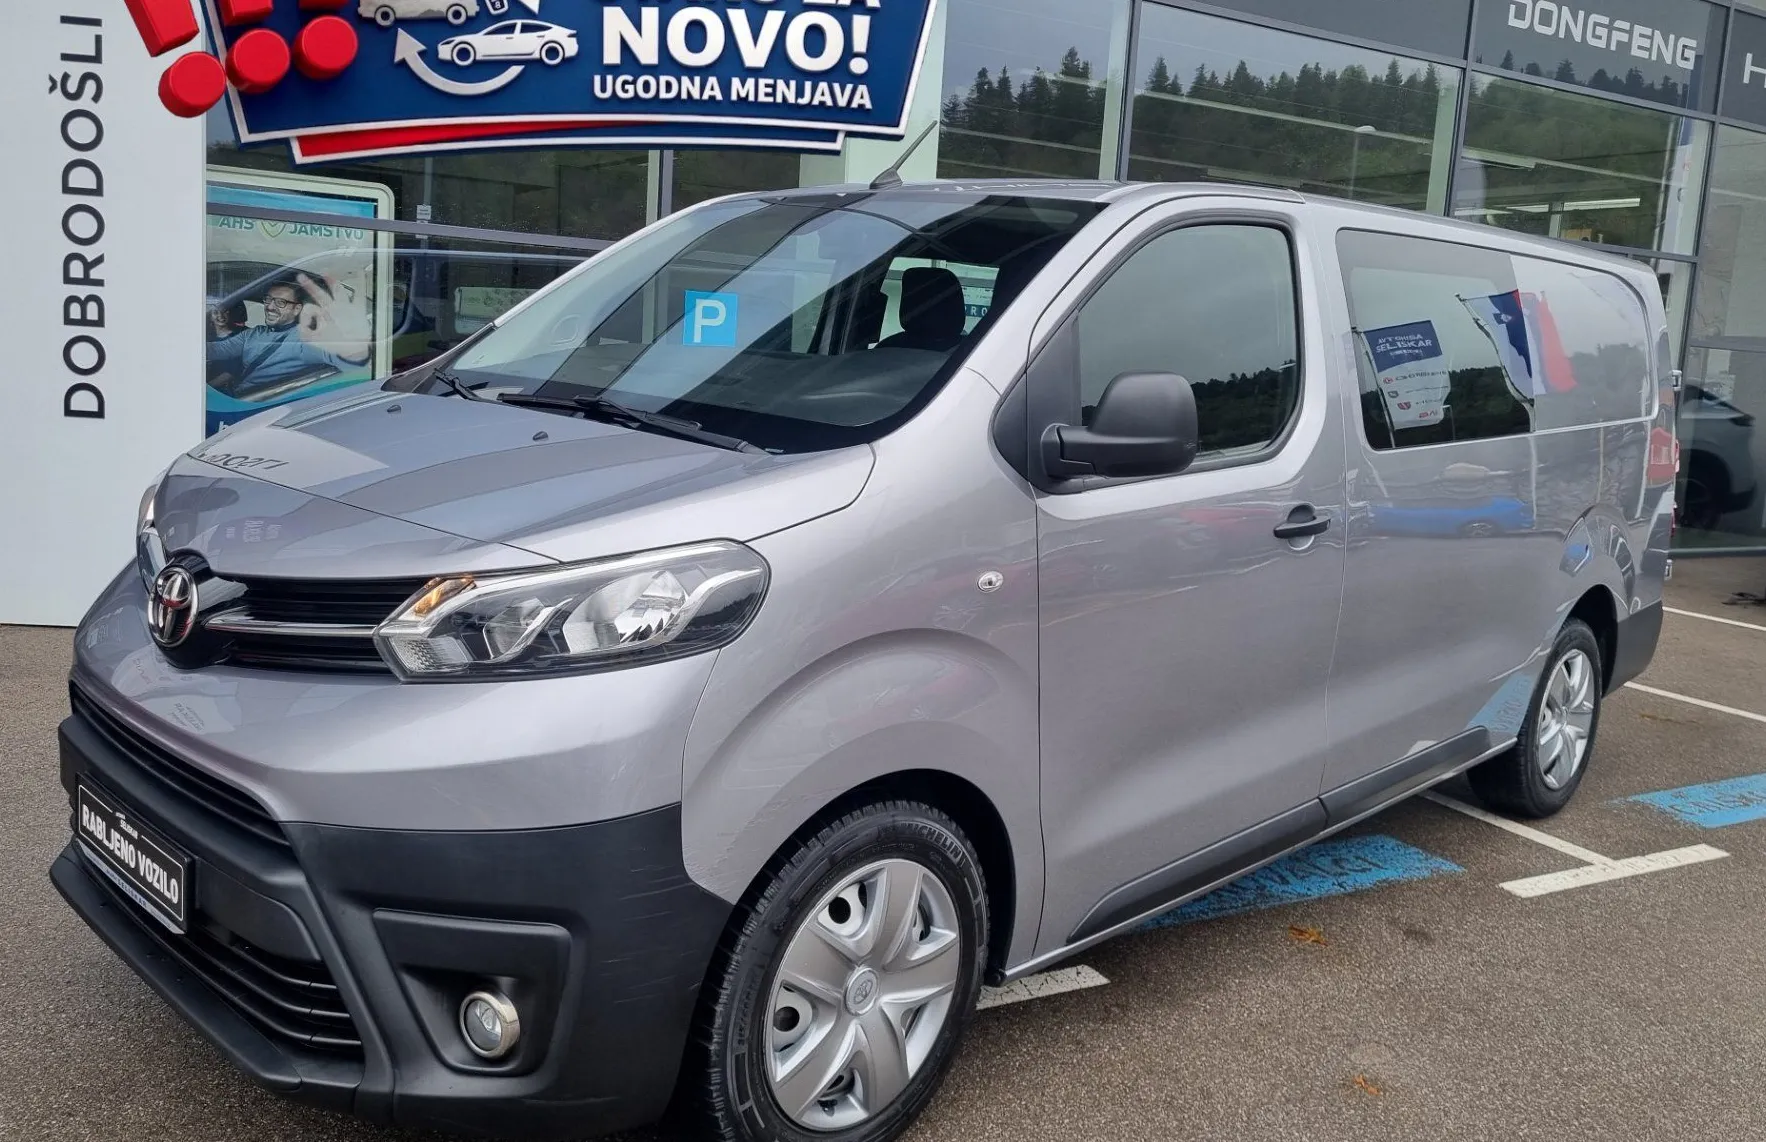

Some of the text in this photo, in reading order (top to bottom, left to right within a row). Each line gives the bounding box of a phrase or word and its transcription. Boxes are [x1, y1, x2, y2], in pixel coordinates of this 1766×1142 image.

[1508, 0, 1697, 70] DONGFENG
[49, 15, 106, 419] DOBRODOŠLI
[694, 298, 727, 343] P
[82, 804, 179, 904] RABLJENO VOZILO
